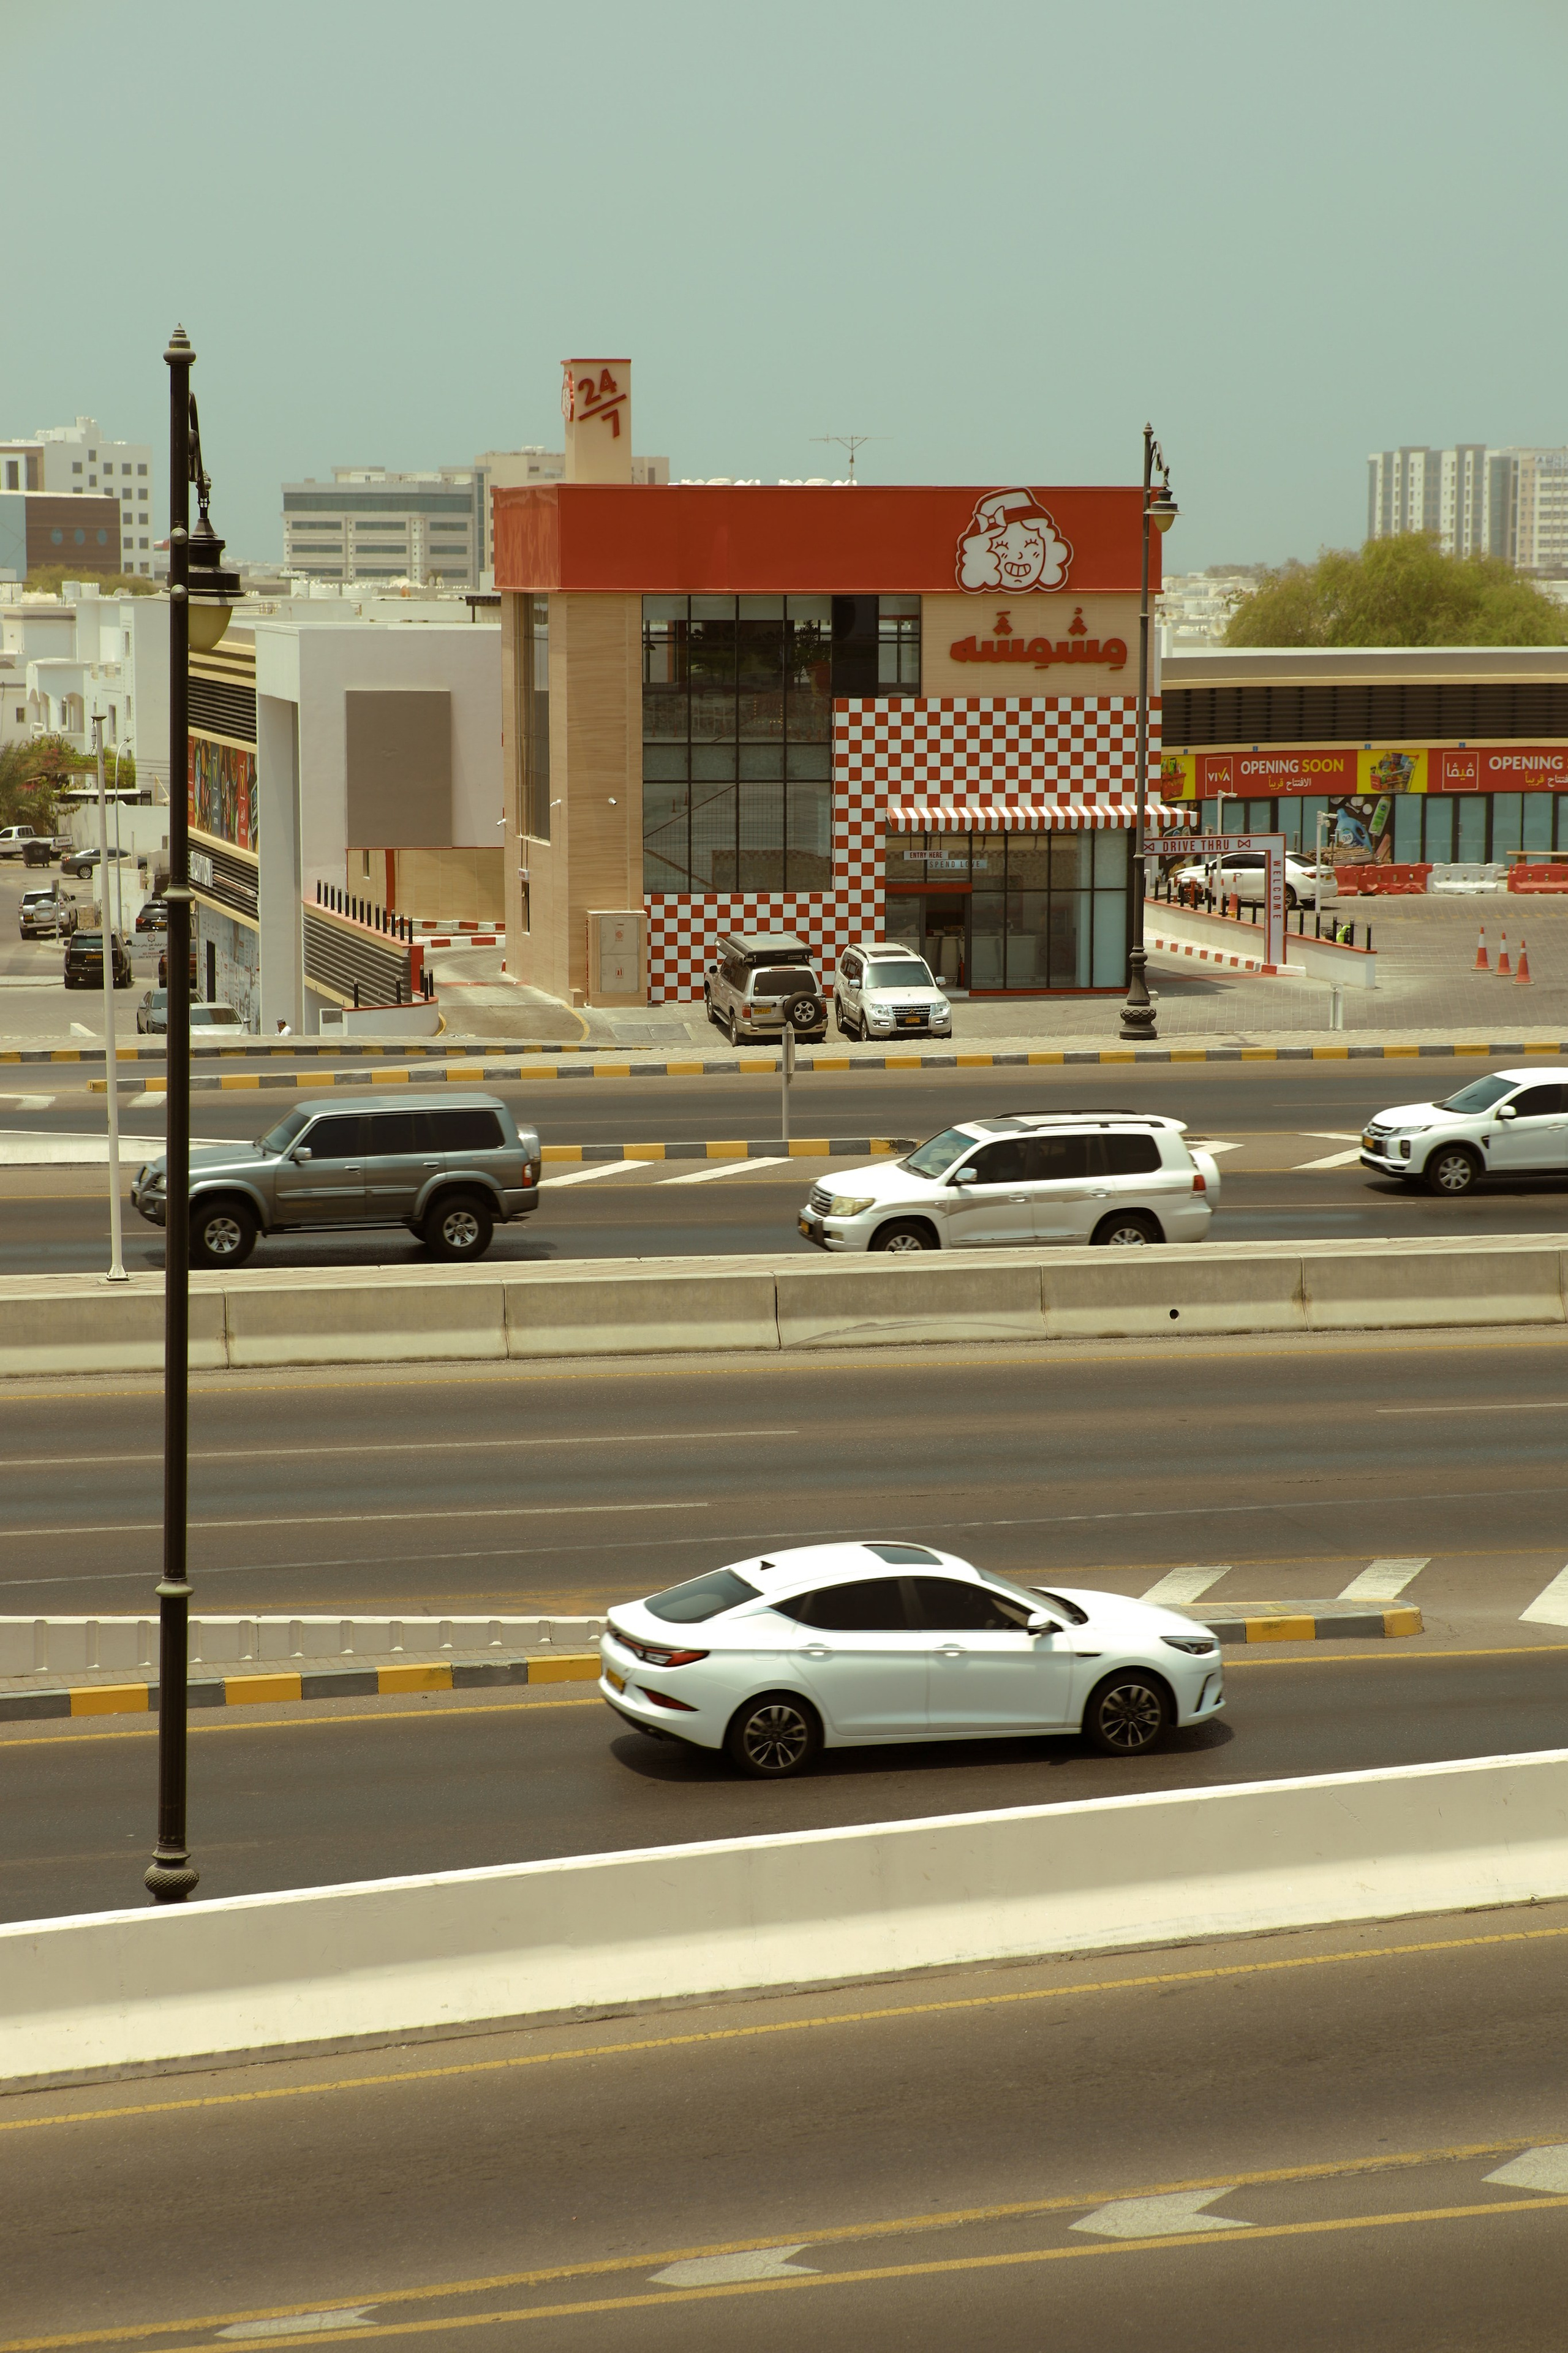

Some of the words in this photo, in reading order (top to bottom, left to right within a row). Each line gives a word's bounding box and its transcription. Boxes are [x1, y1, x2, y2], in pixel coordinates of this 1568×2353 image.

[1240, 760, 1299, 774] OPENING
[1302, 758, 1344, 772] SOON
[1488, 755, 1564, 770] OPENING
[1207, 767, 1231, 782] VIVA
[1286, 777, 1311, 791] الافتتاح
[1163, 840, 1196, 852] DRIVE
[1200, 839, 1229, 851] THRU
[1273, 860, 1281, 919] WELCOME
